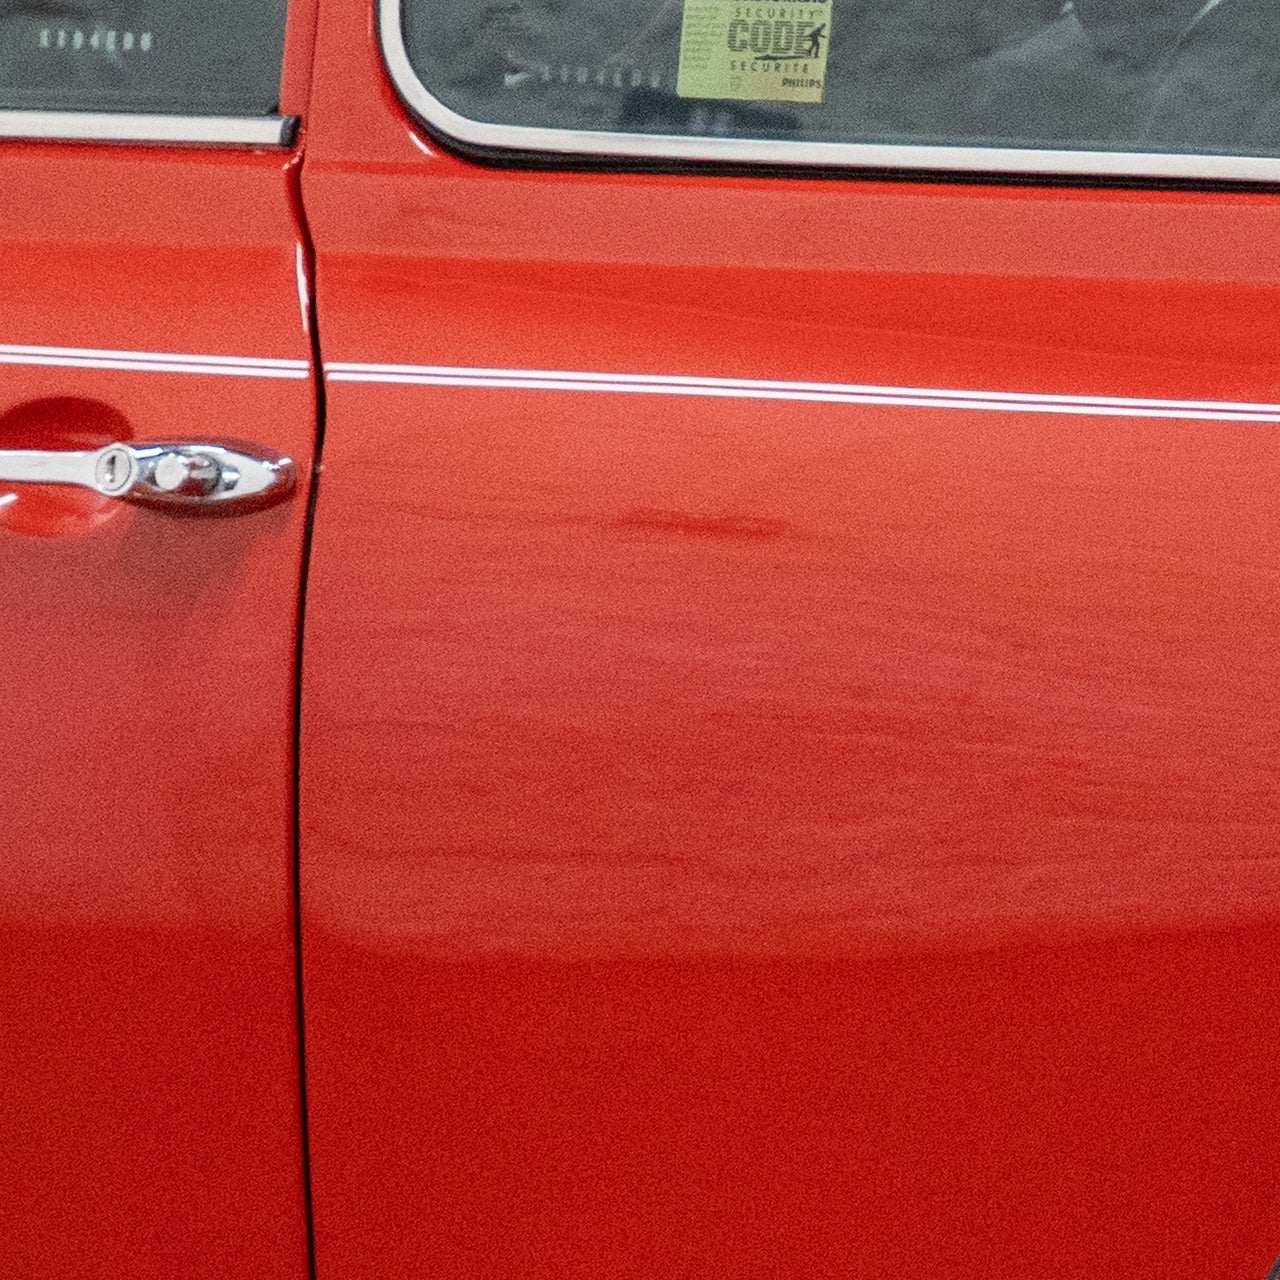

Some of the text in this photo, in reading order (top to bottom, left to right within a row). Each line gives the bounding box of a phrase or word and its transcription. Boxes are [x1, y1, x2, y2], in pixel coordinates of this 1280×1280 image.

[735, 7, 816, 18] SECURITY
[727, 19, 816, 55] CODE
[782, 78, 821, 89] PHILIPS
